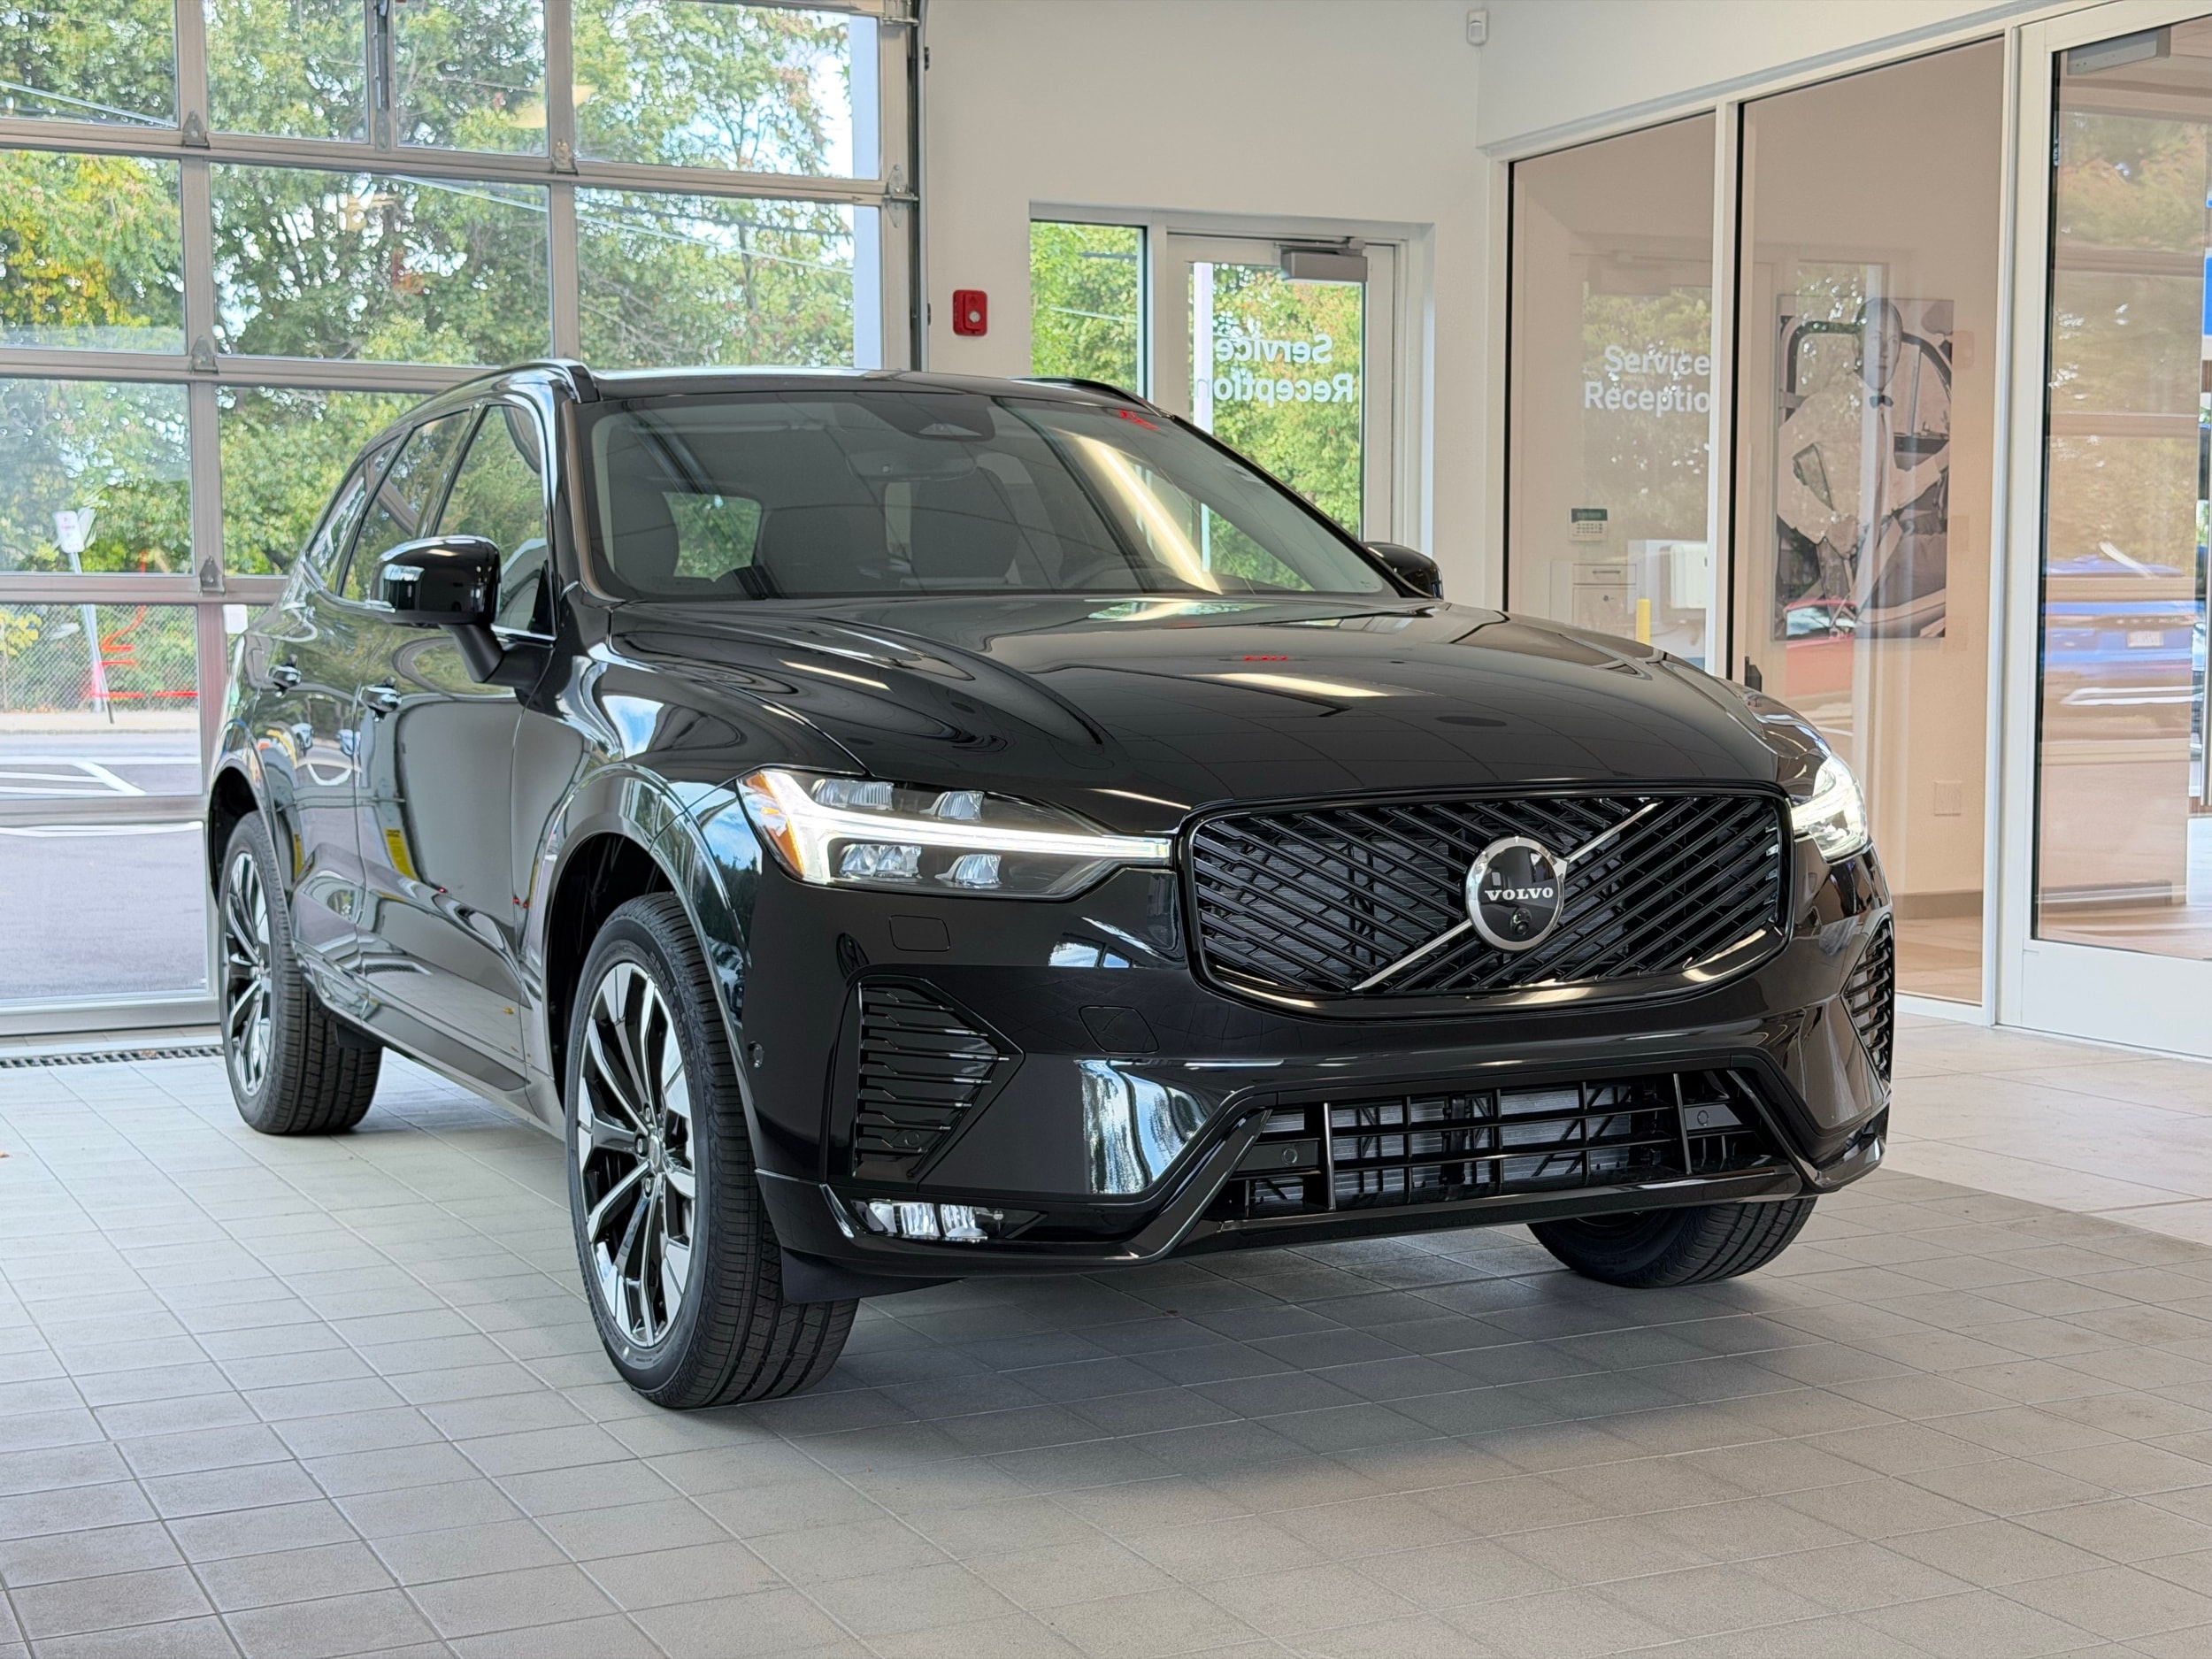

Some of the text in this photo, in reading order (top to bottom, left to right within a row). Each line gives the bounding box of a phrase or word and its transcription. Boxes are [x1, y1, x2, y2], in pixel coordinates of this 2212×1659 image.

[1604, 344, 1710, 376] Service
[1585, 380, 1711, 418] Receptio
[1484, 887, 1554, 902] VOLVO
